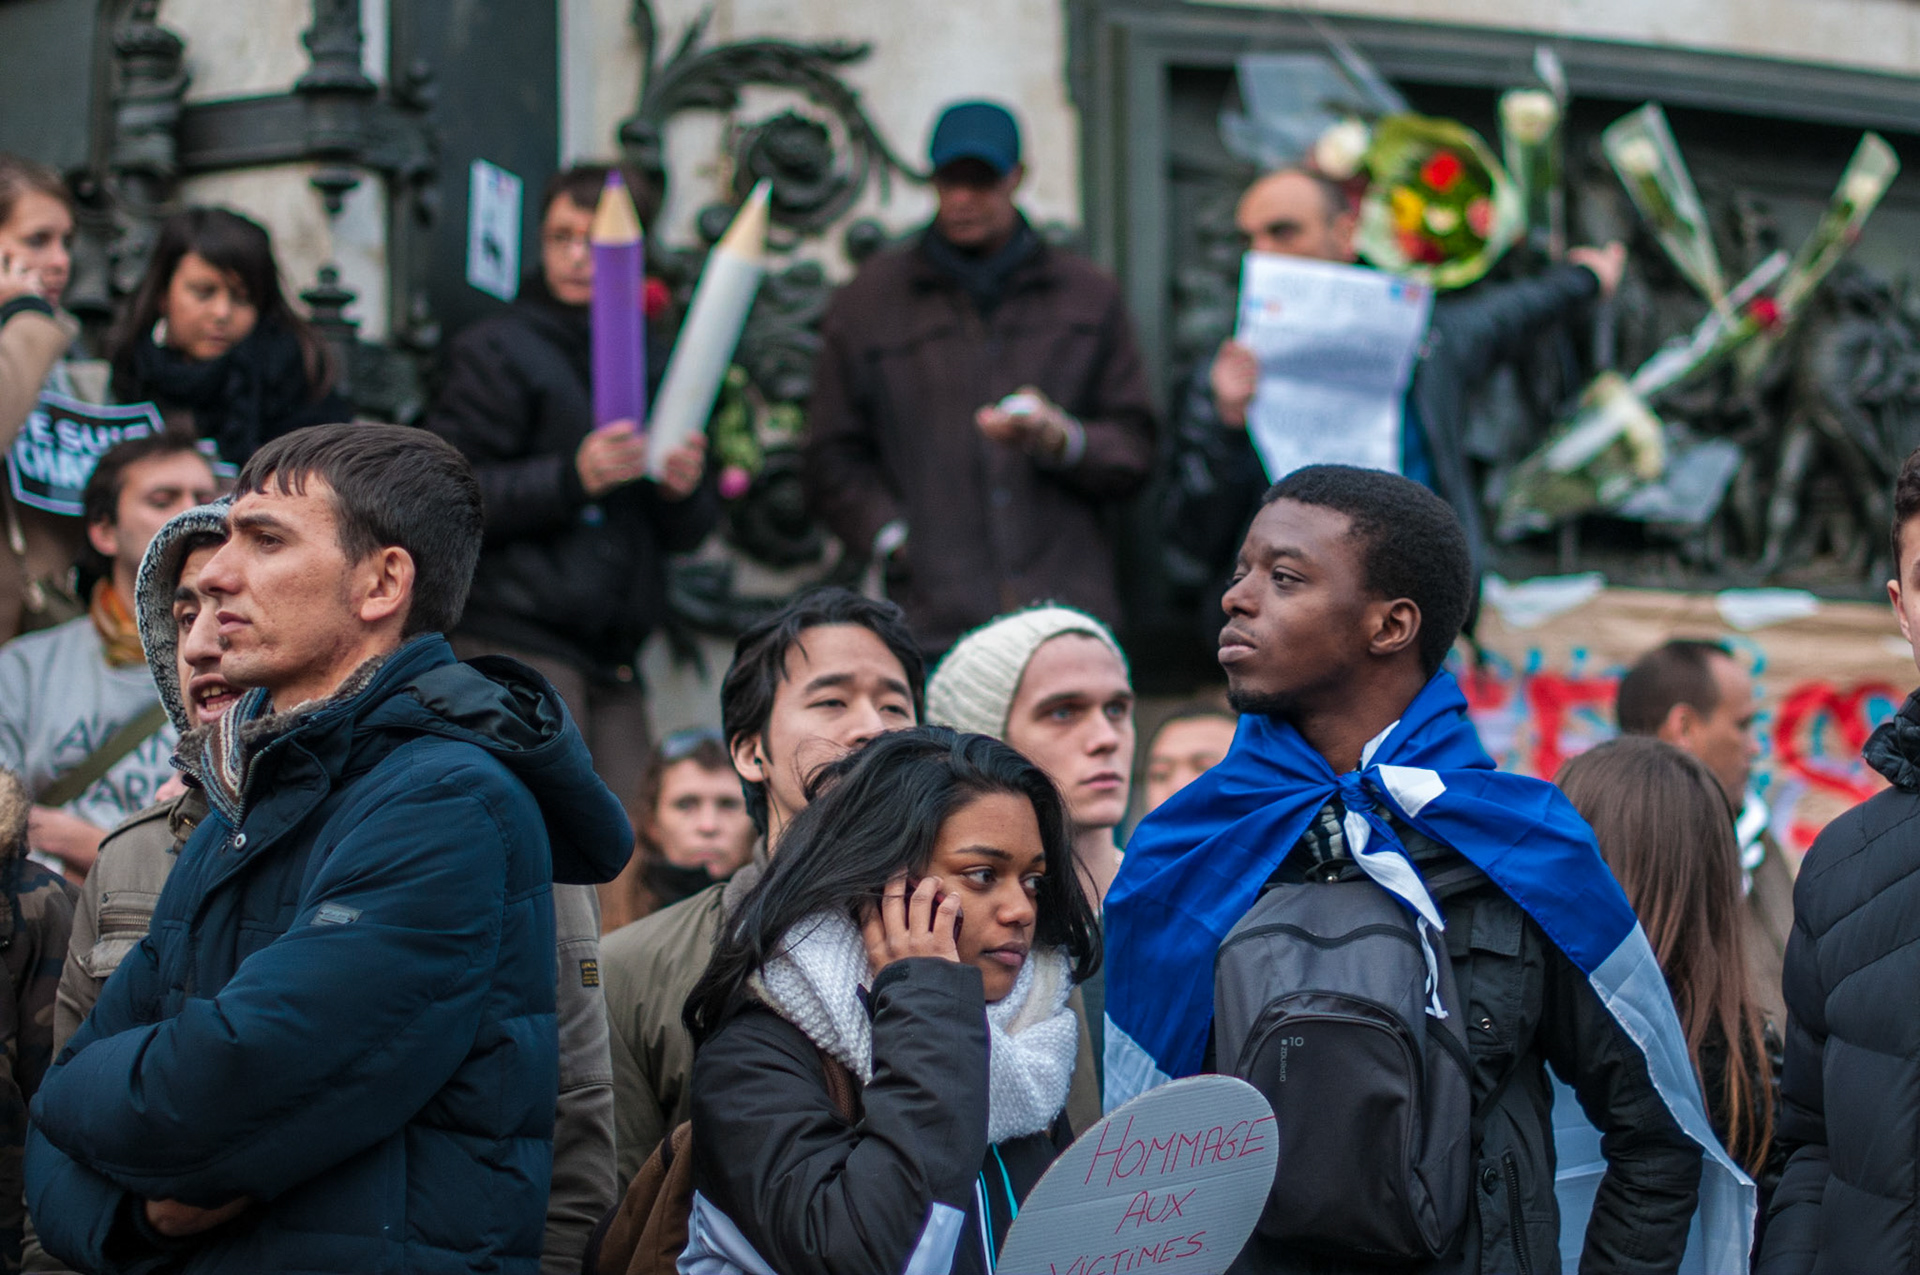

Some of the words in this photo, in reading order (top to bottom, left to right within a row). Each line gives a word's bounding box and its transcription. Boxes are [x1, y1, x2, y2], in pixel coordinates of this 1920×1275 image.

[1289, 1036, 1304, 1047] 10
[1084, 1115, 1276, 1187] HOMMAGE
[1115, 1188, 1197, 1234] AUX
